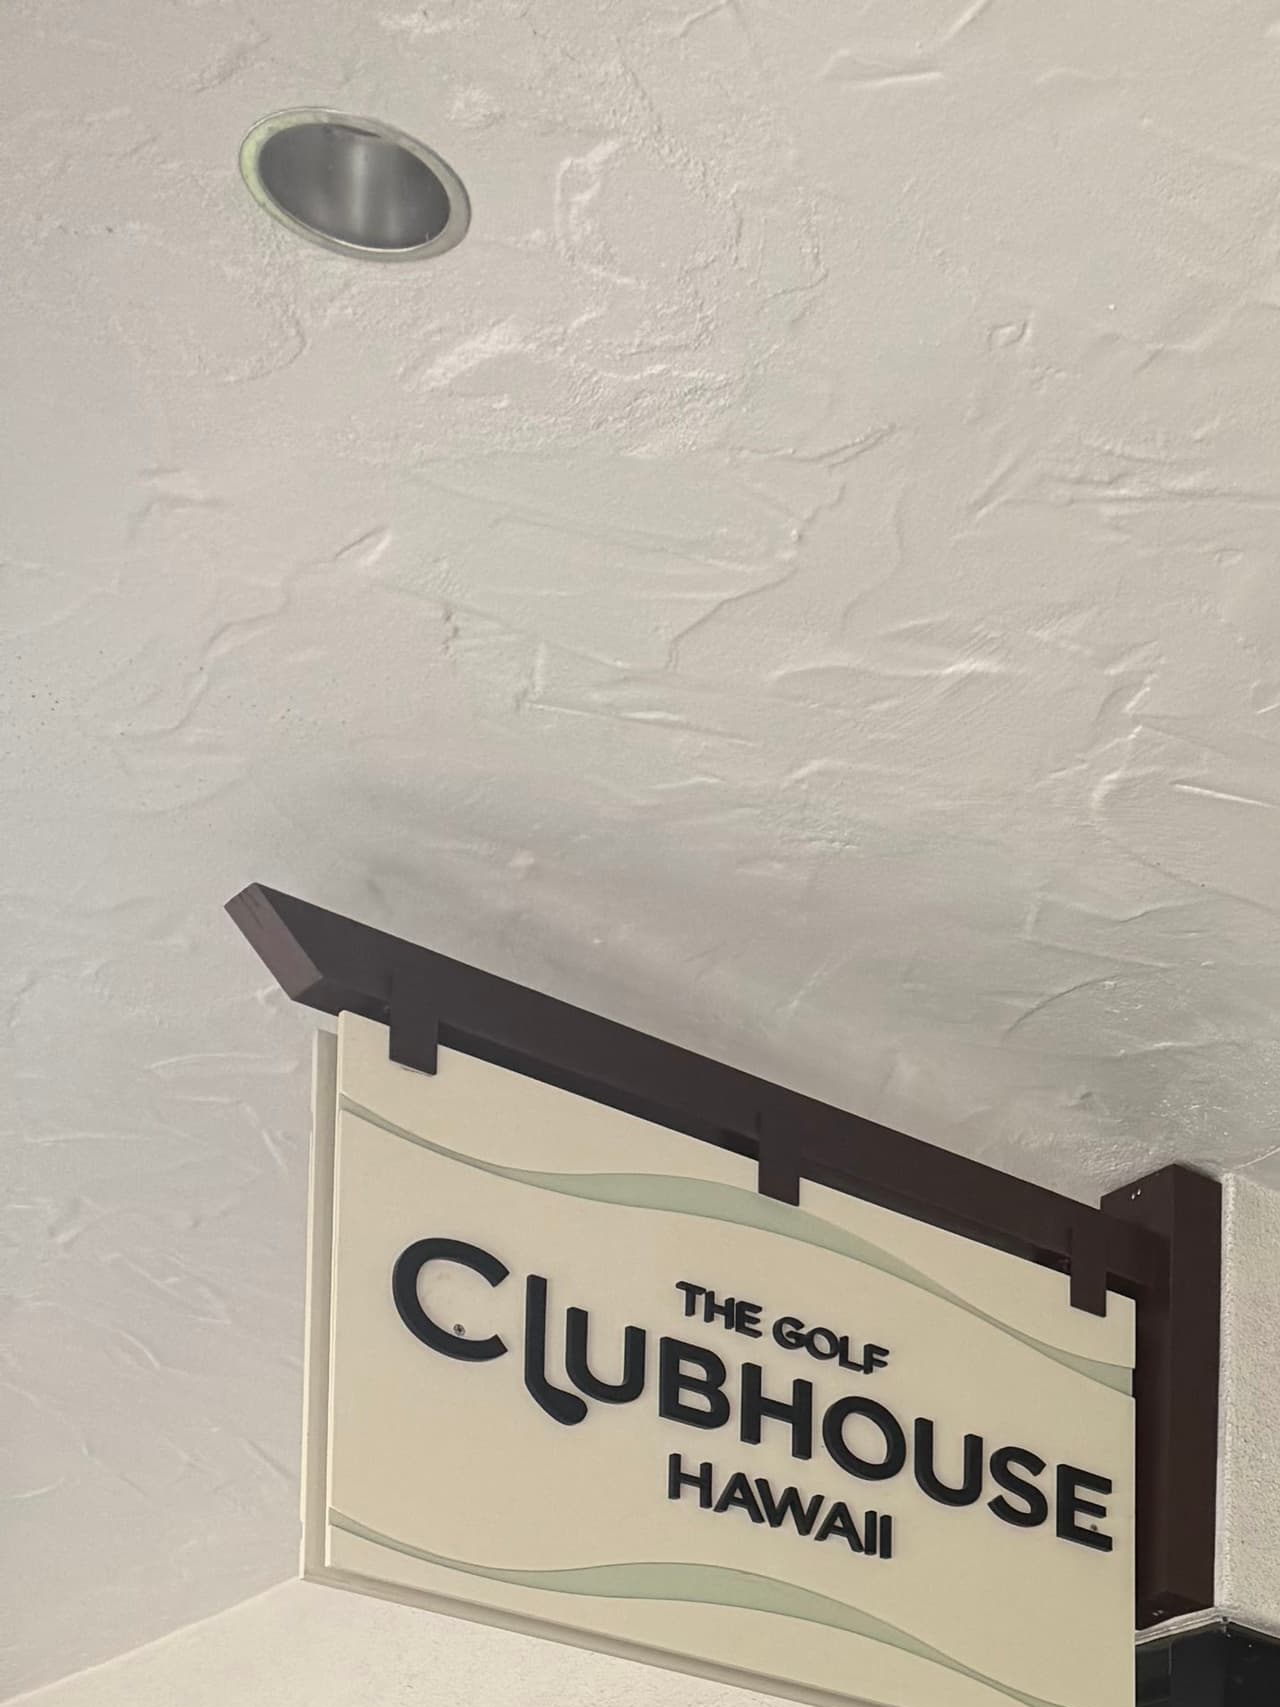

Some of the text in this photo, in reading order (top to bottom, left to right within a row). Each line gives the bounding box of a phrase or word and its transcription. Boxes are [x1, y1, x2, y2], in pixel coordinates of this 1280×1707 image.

[675, 1280, 890, 1375] THE GOLF
[392, 1237, 1113, 1553] CLUBHOUSE
[668, 1453, 893, 1560] HAWAII
